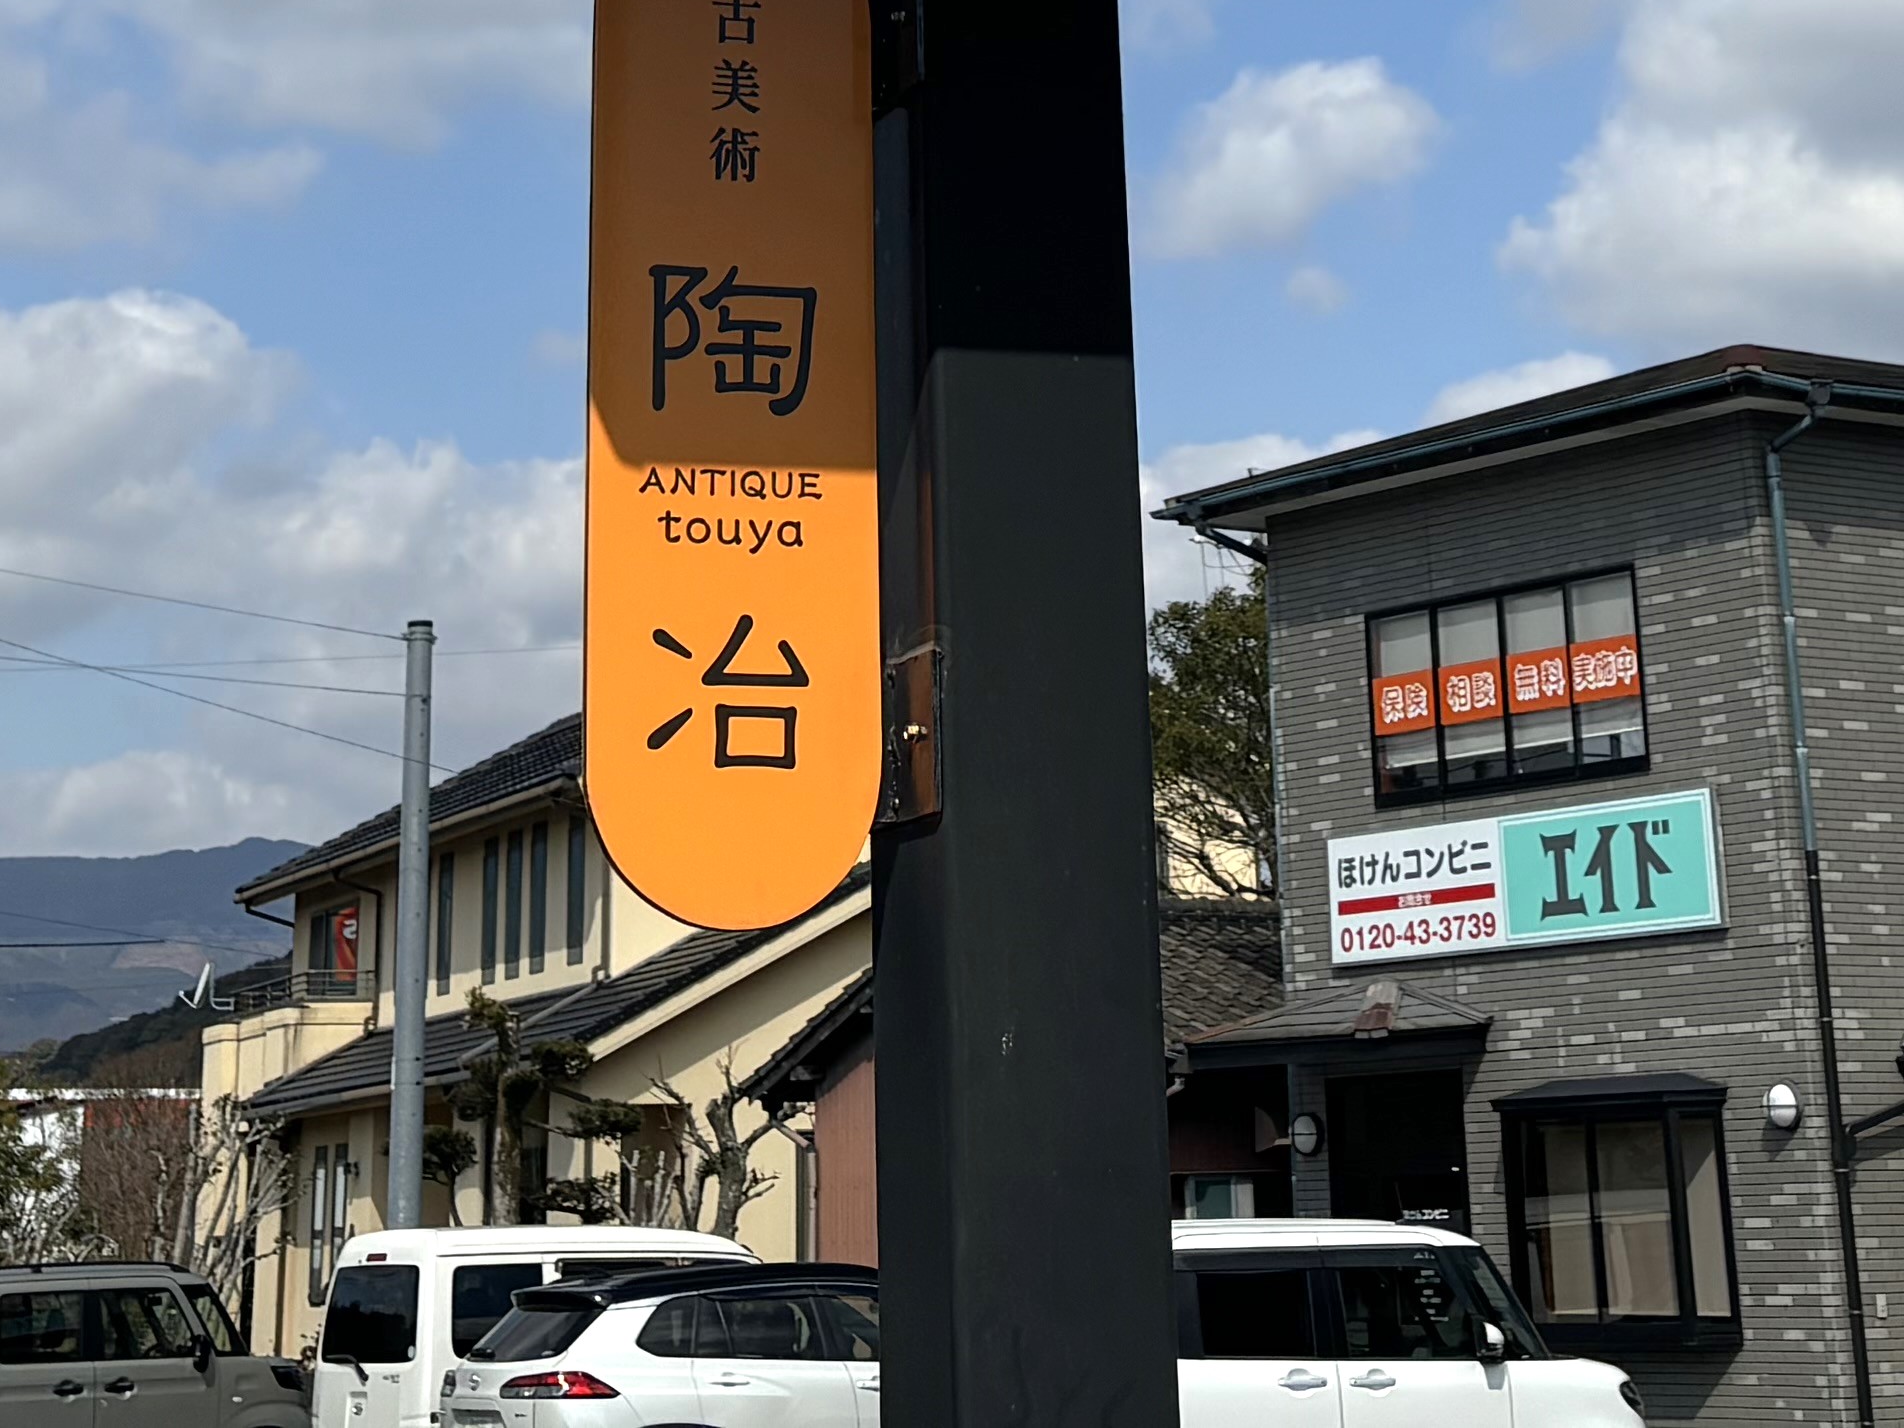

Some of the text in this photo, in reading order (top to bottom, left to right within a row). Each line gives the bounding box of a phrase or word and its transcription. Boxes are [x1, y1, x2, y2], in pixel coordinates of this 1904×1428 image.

[648, 262, 818, 417] 陶
[638, 466, 823, 501] ANTIQUE
[657, 510, 804, 555] touya
[1337, 839, 1492, 889] ほけんコンビニ
[1540, 818, 1672, 922] エイド
[1340, 911, 1497, 954] 0120-43-3739
